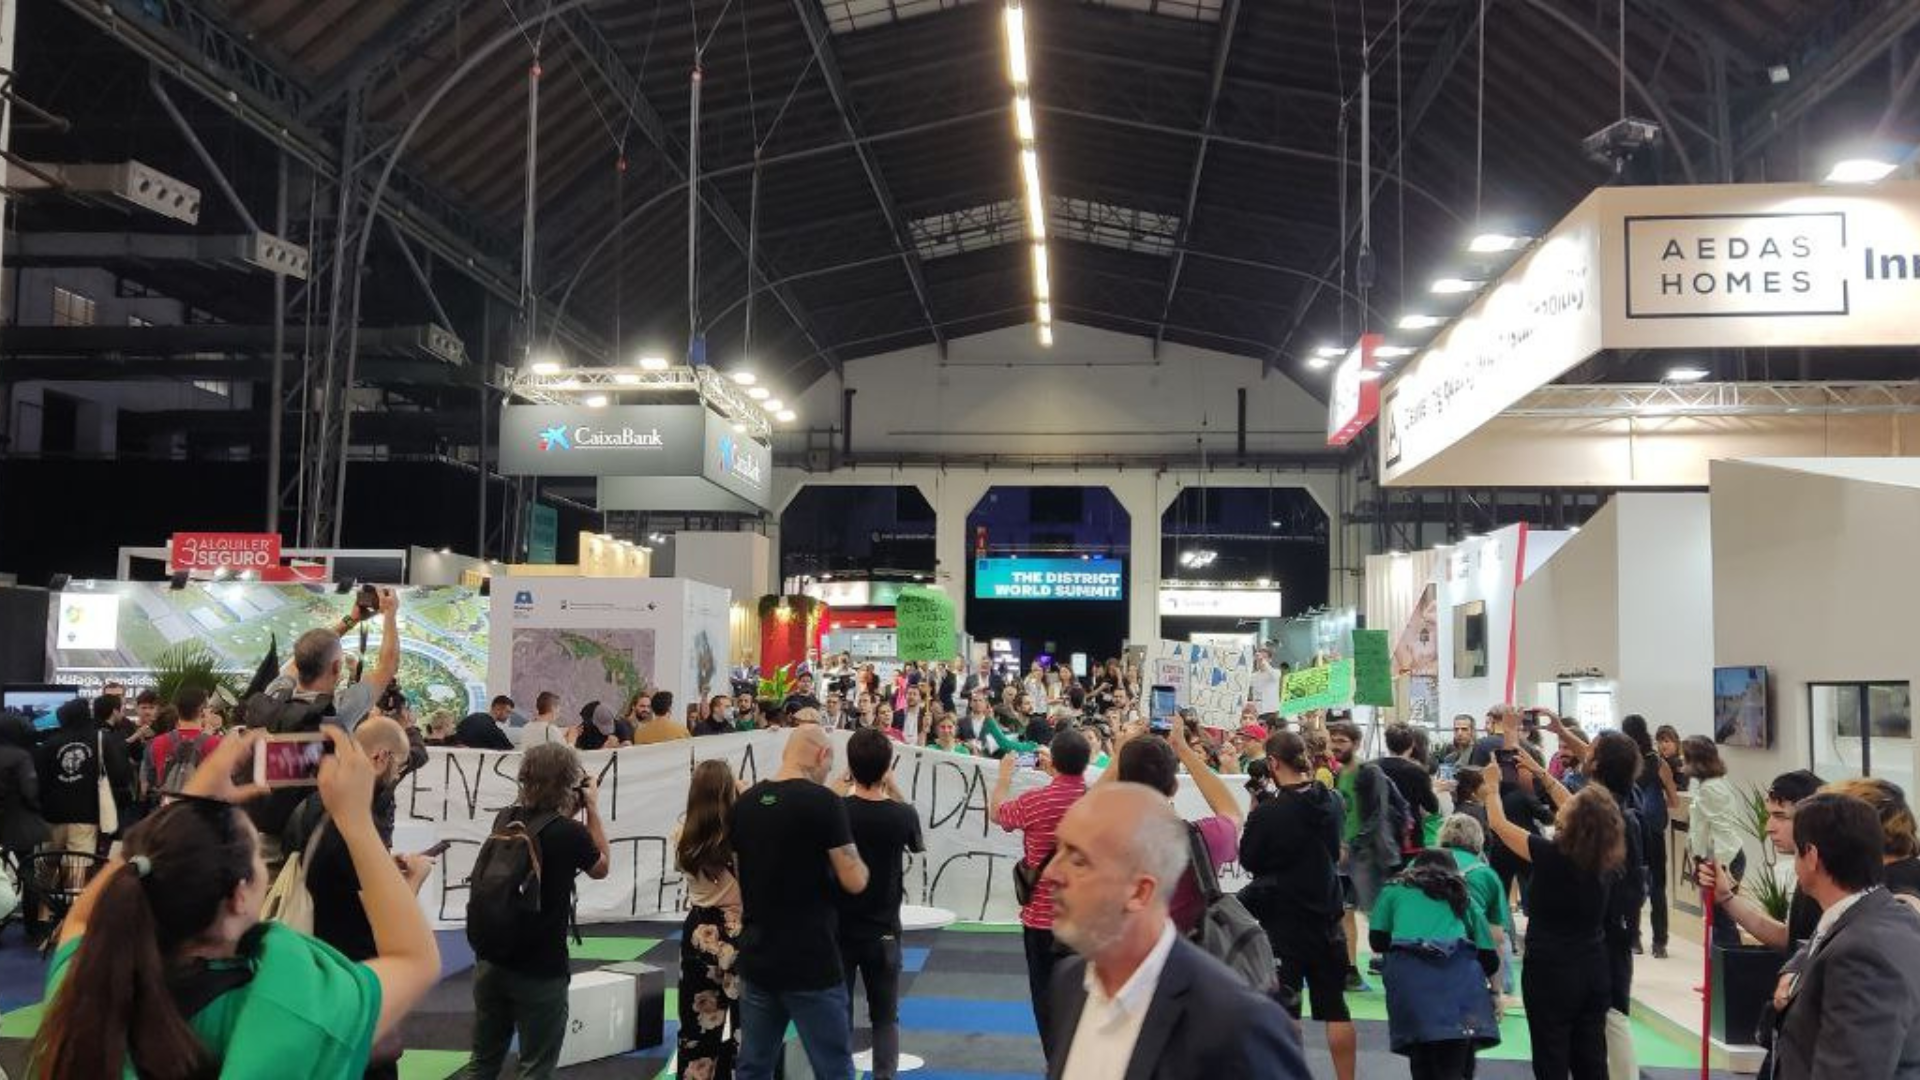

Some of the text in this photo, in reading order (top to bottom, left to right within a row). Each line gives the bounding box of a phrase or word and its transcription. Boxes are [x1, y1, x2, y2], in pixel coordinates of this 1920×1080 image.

[1662, 237, 1811, 261] AEDAS
[1864, 247, 1920, 280] In
[1662, 271, 1811, 295] HOMES
[574, 427, 663, 445] CaixaBank
[199, 540, 269, 551] ALQUILER
[198, 551, 270, 565] SEGURO
[1012, 572, 1120, 585] THE DISTRICT
[994, 584, 1120, 598] WORLD SUMMIT
